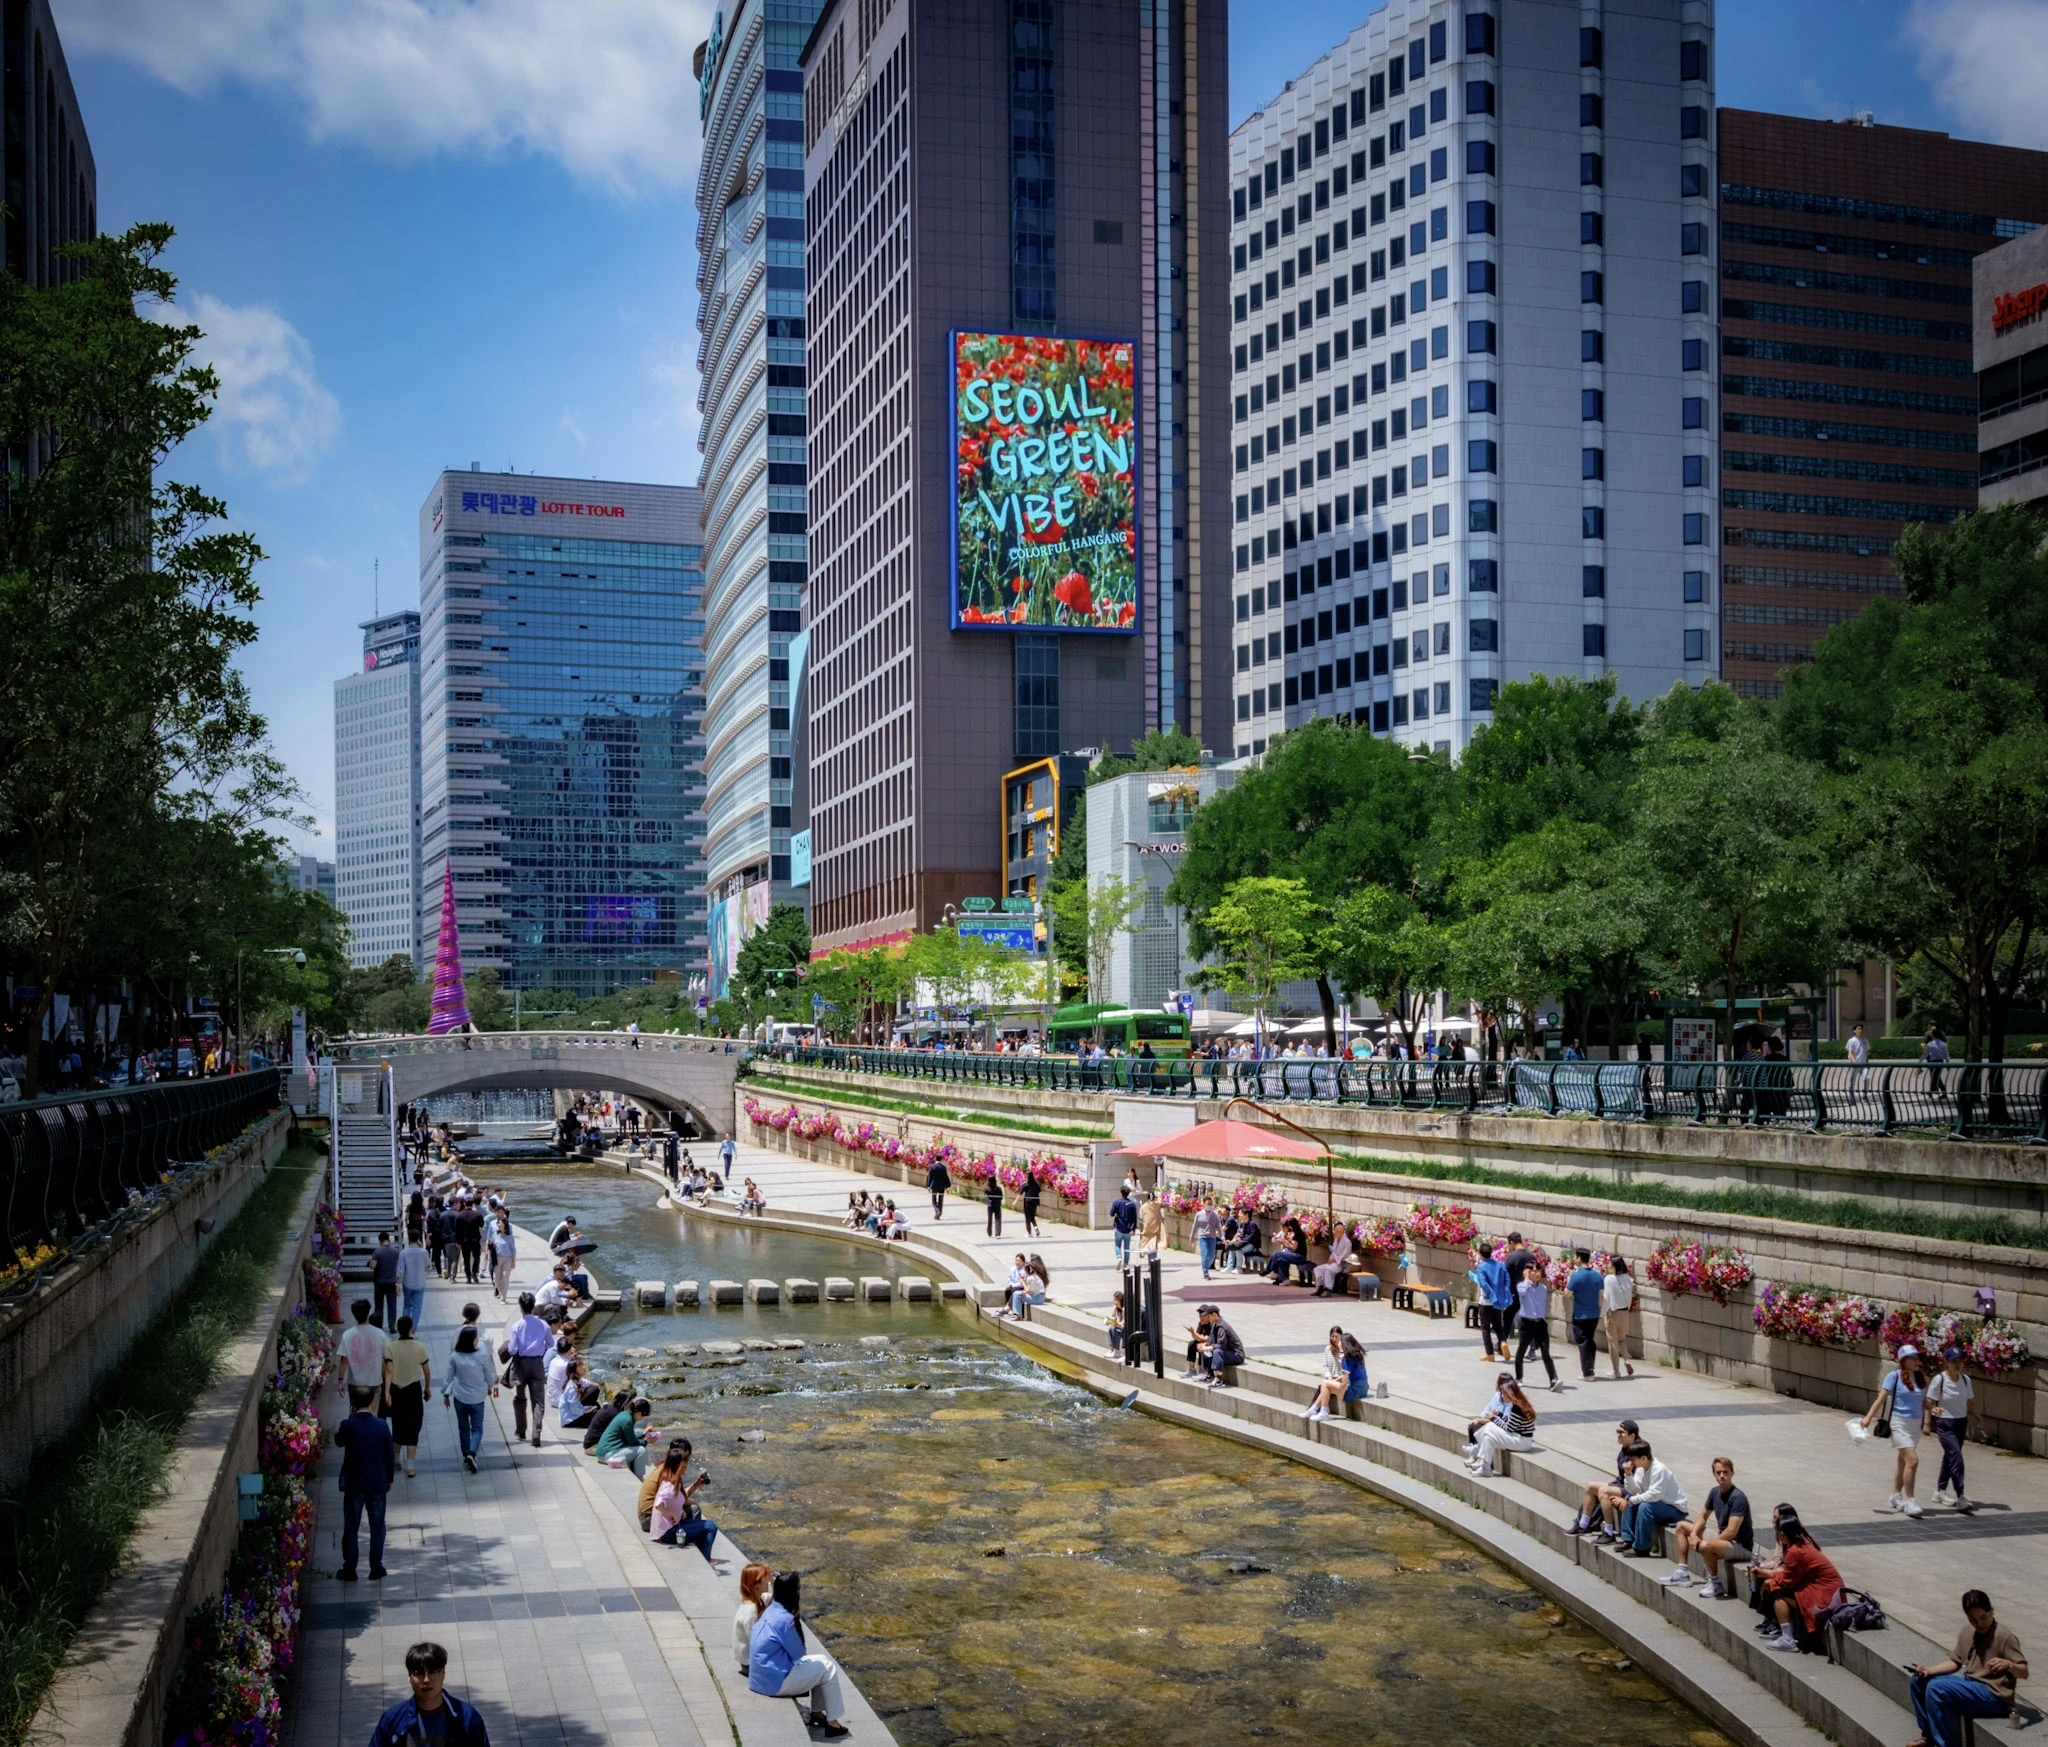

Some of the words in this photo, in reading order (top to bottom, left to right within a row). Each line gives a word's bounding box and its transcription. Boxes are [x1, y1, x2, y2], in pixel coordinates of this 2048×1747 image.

[964, 375, 1117, 425] SEOUL,
[990, 430, 1130, 481] GREEN
[461, 491, 538, 517] 롯데관광
[541, 501, 584, 516] LOTTE
[587, 504, 625, 518] TOUR
[978, 485, 1076, 534] VIBE
[1009, 542, 1070, 561] COLORFUL
[1071, 531, 1128, 550] HANGANG
